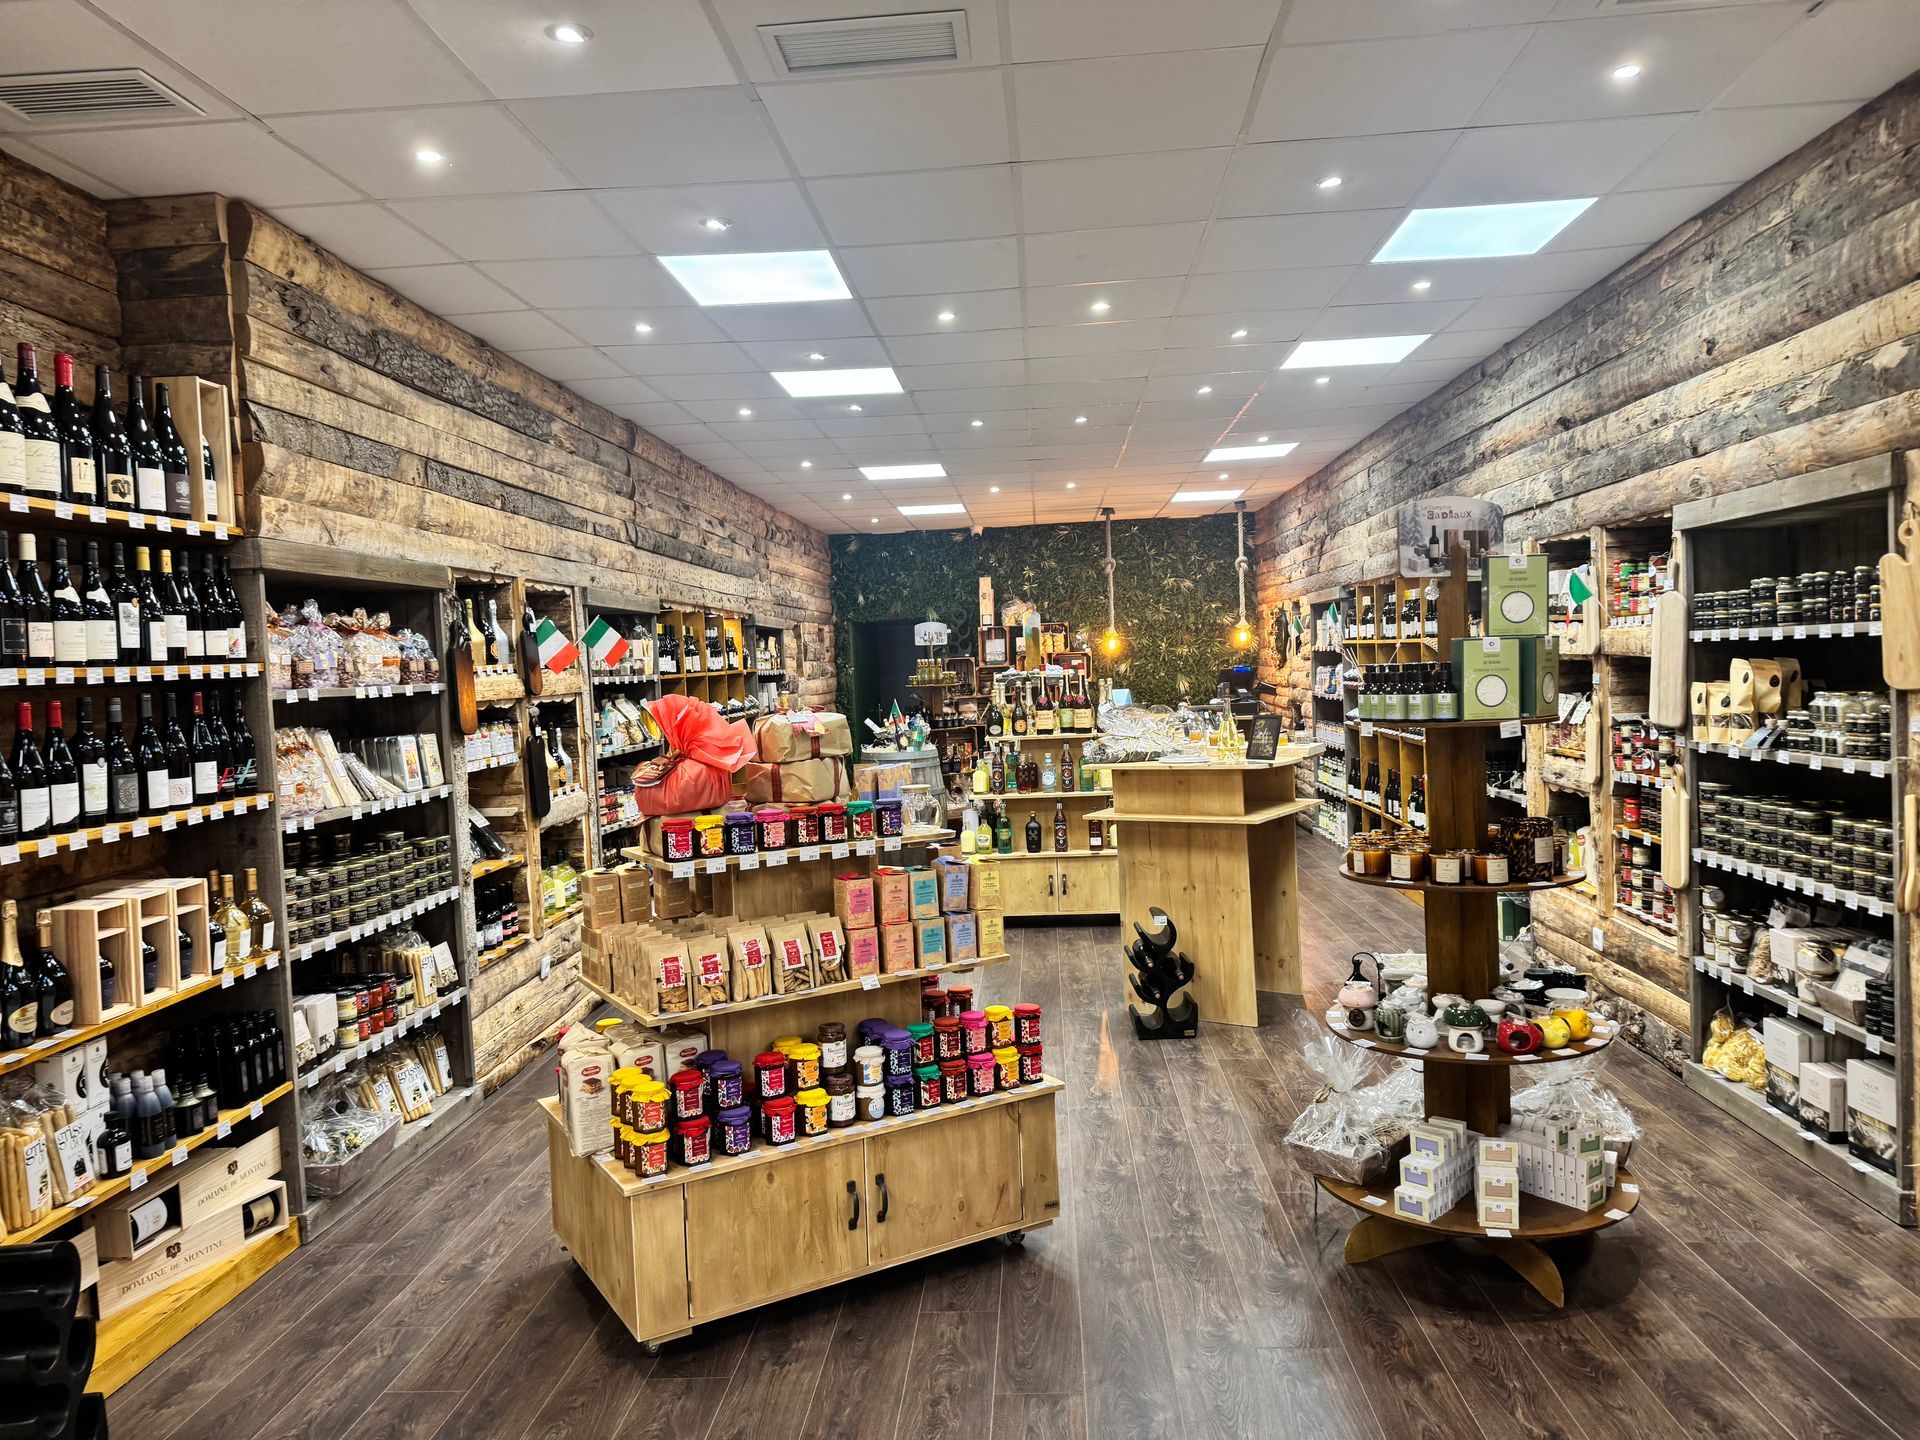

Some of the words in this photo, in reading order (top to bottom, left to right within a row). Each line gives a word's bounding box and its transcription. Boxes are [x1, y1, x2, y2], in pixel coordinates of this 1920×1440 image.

[121, 1265, 168, 1295] DOMAINE
[170, 1262, 181, 1272] DE
[183, 1239, 225, 1265] MONTINE
